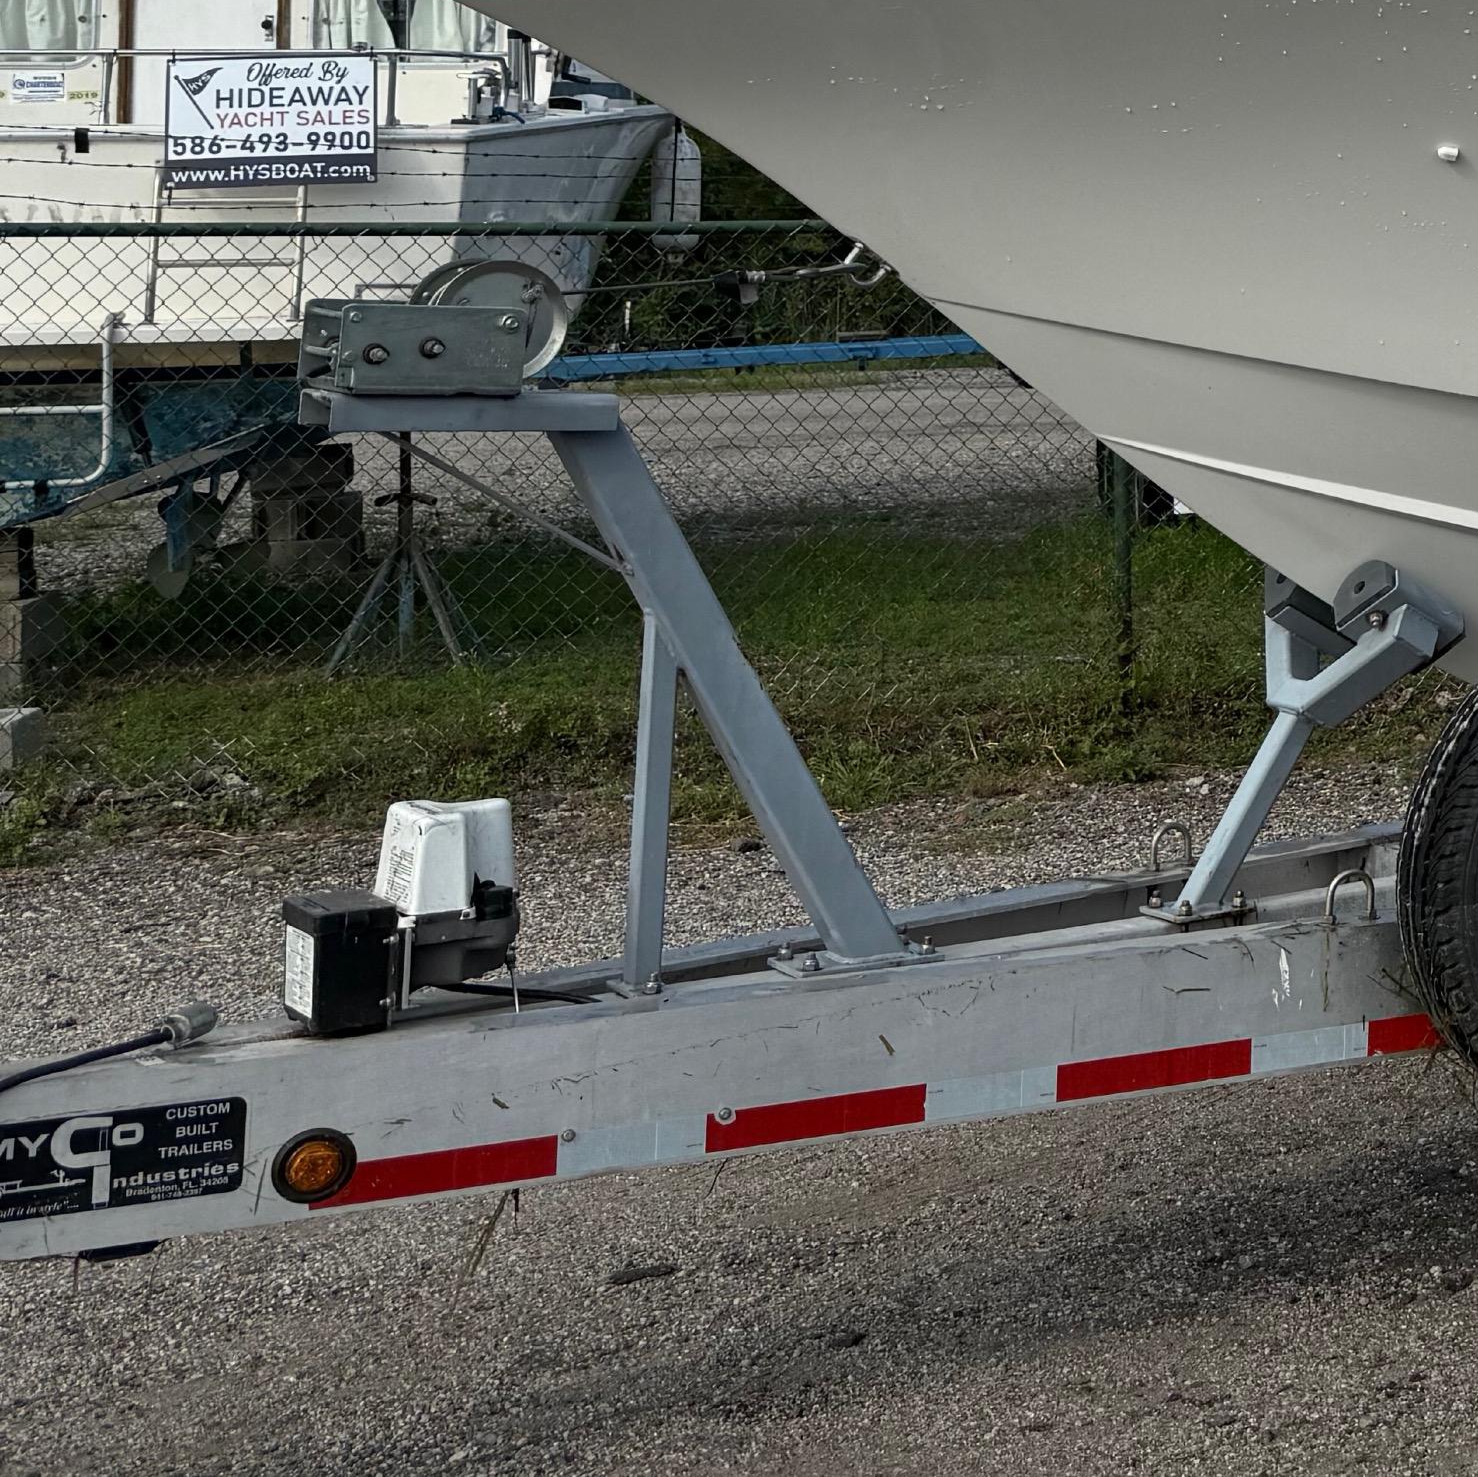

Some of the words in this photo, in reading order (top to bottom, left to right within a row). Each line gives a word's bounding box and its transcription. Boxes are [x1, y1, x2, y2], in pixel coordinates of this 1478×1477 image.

[189, 72, 212, 91] HYS
[246, 62, 314, 86] Offered
[318, 60, 349, 85] By
[215, 85, 370, 109] HIDEAWAY
[216, 111, 289, 129] YACHT
[296, 109, 370, 126] SALES
[172, 131, 370, 156] 586-493-9900
[172, 162, 371, 182] www.HYSBOAT.com
[166, 1101, 230, 1120] CUSTOM
[175, 1122, 219, 1138] BUILT
[158, 1138, 233, 1159] TRAILERS
